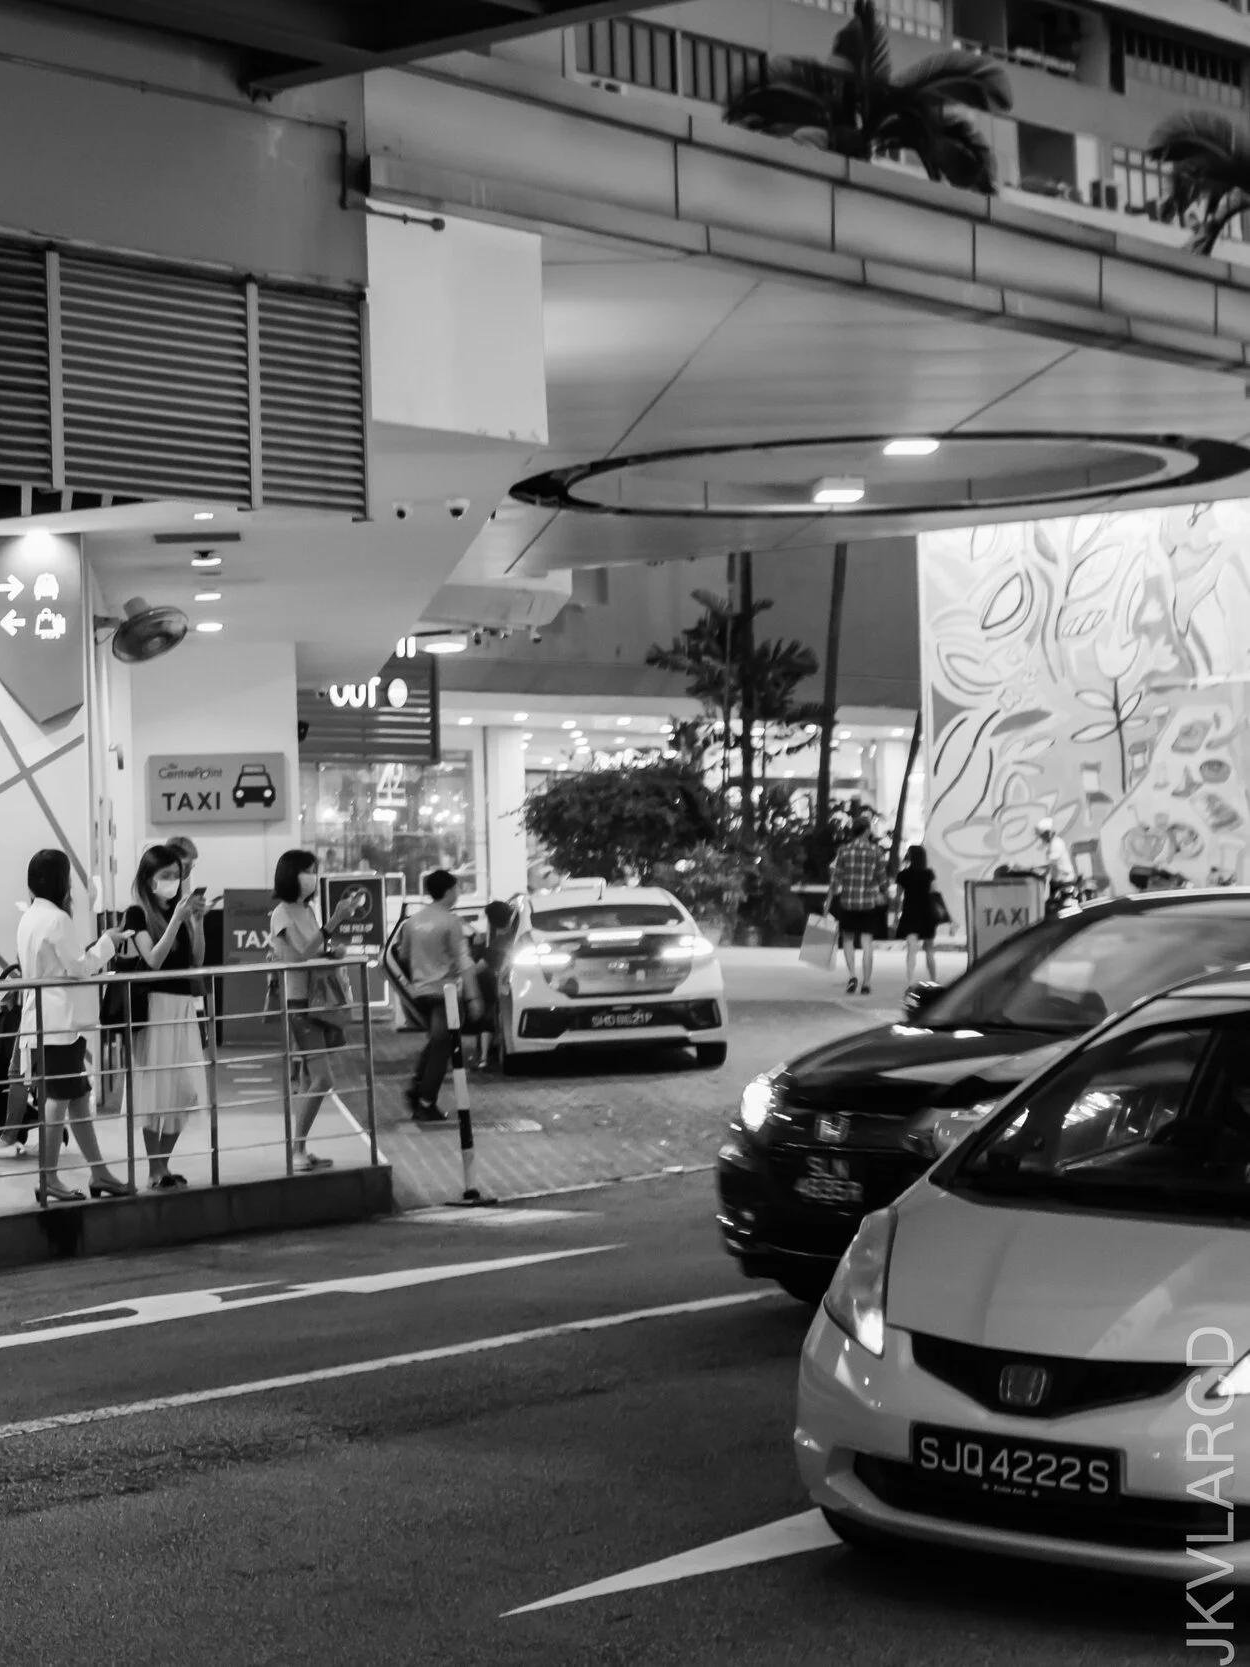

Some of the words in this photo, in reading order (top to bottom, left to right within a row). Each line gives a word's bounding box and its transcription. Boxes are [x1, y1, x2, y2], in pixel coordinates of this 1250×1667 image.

[161, 791, 221, 812] TAXI
[984, 907, 1029, 927] TAXI
[233, 929, 274, 949] TAX
